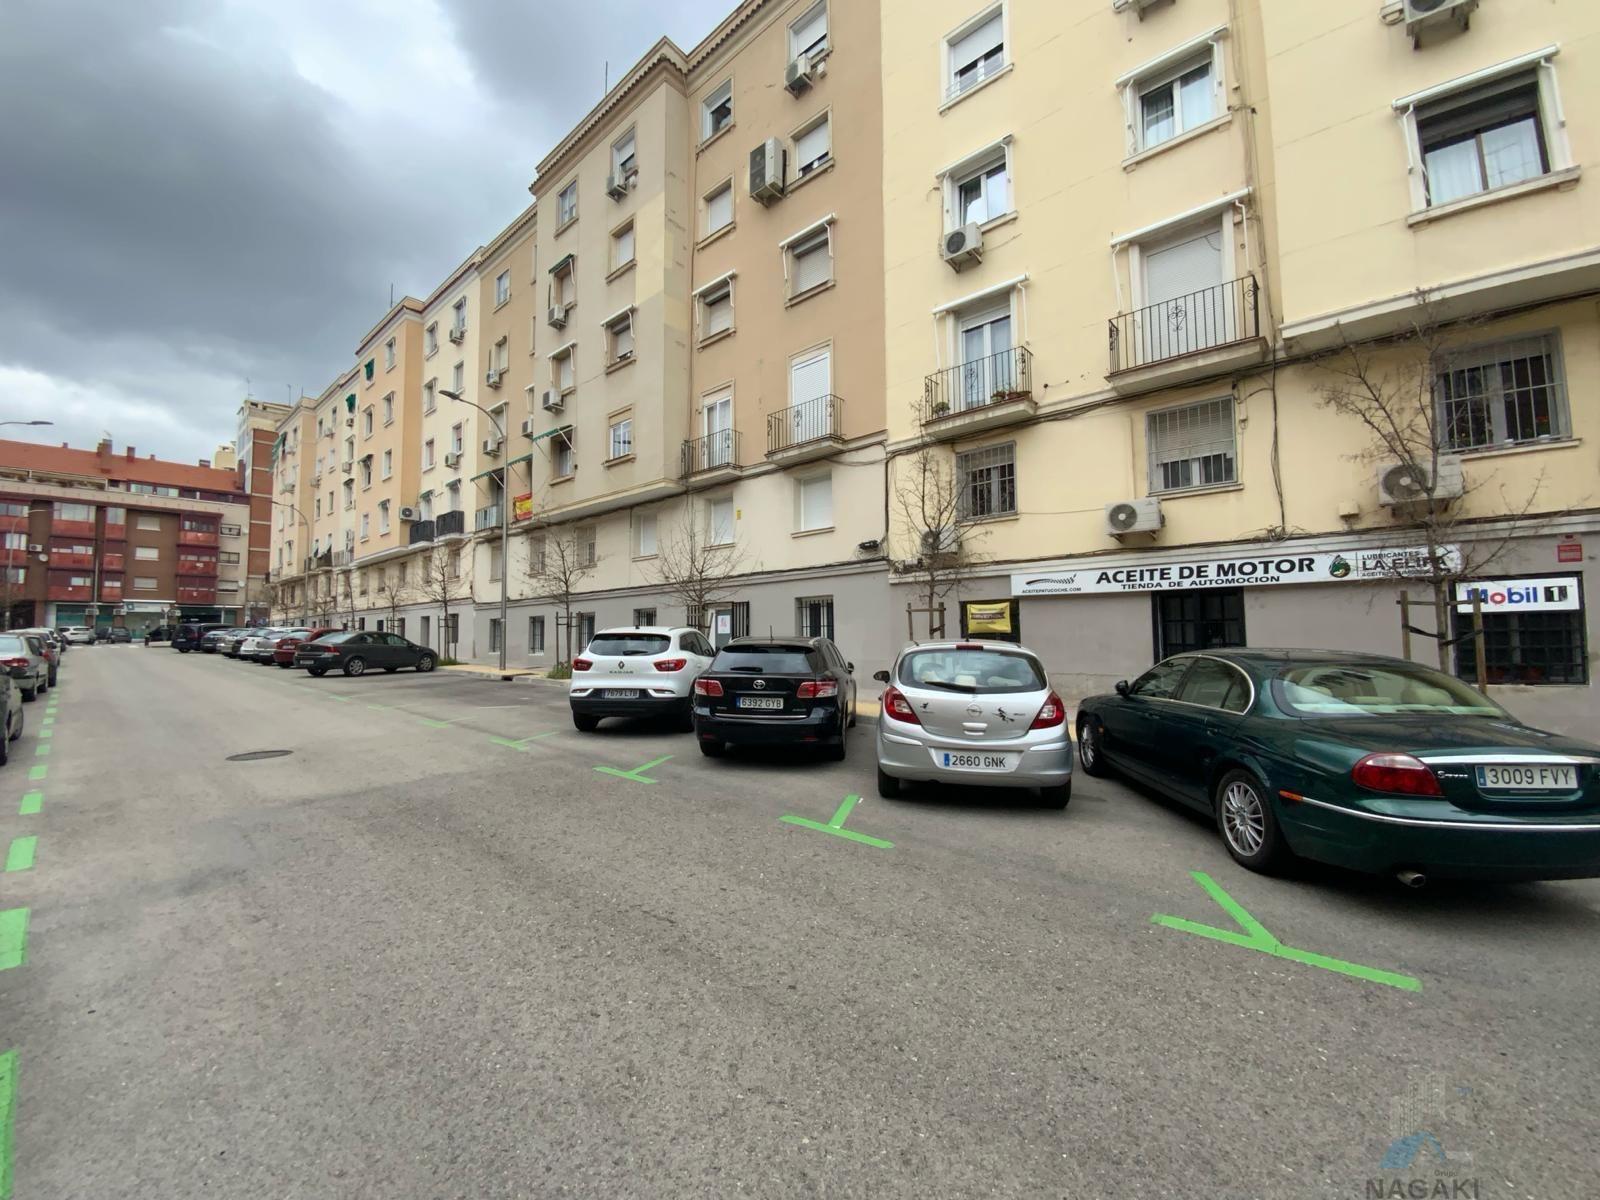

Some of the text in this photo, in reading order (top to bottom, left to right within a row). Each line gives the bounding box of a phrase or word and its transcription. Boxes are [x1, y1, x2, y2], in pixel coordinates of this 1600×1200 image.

[1096, 557, 1315, 584] ACEITE DE MOTOR
[1362, 559, 1386, 571] LA
[1120, 575, 1280, 590] TIENDA DE AUTOMOCION
[1466, 587, 1538, 604] Mobil
[741, 697, 782, 708] 6392 GYB
[952, 755, 1006, 768] 2660 GNK
[1489, 768, 1570, 785] 3009 FVY
